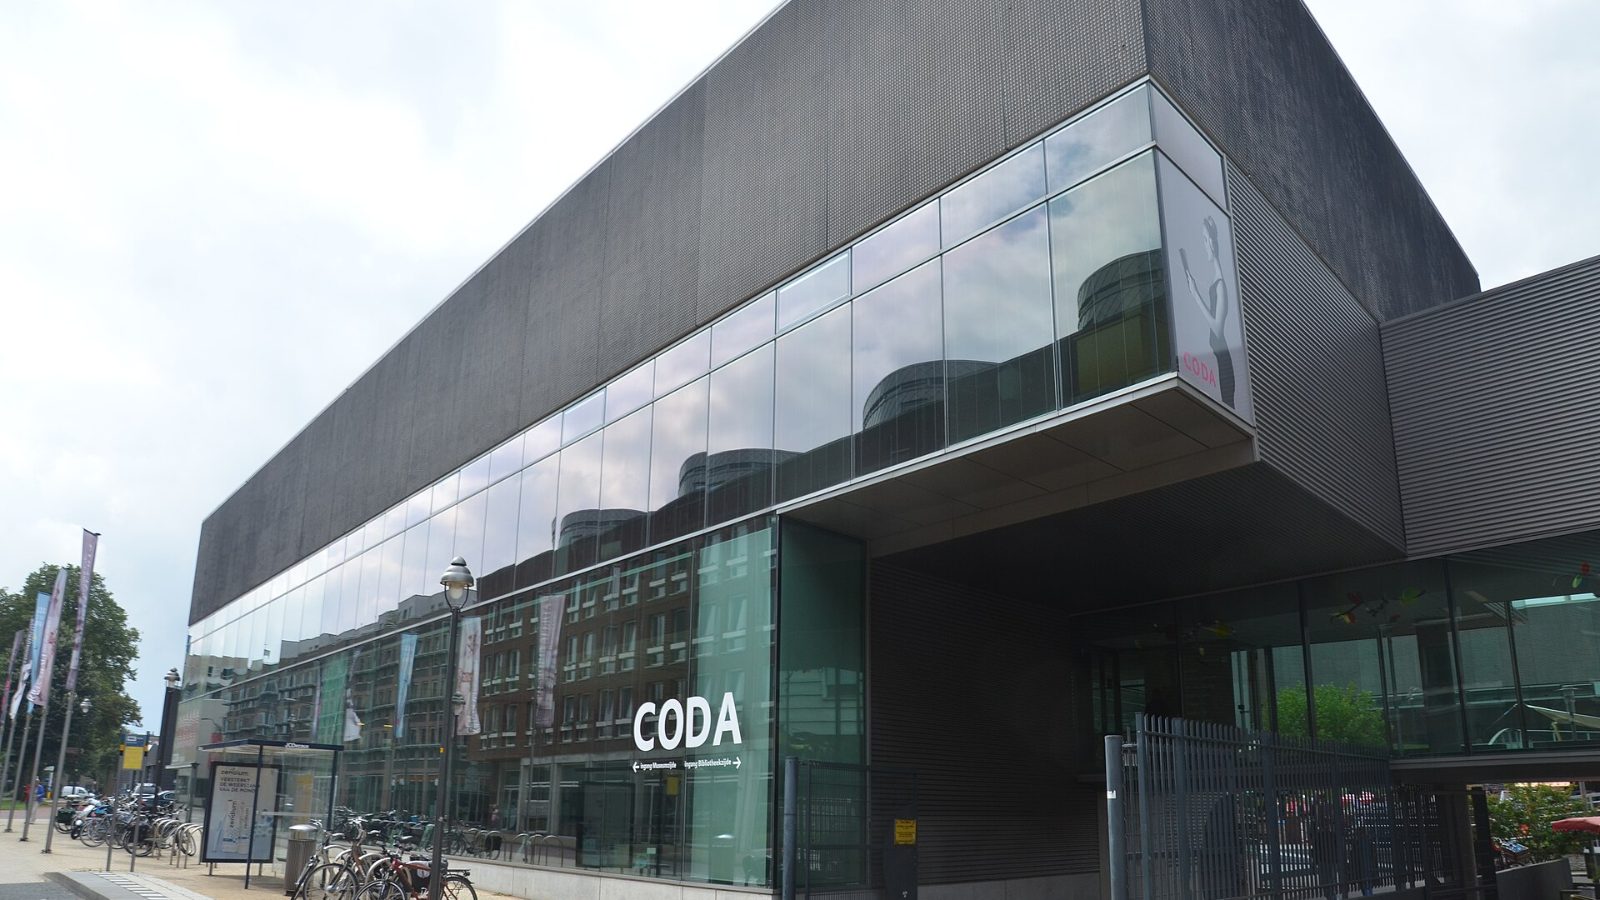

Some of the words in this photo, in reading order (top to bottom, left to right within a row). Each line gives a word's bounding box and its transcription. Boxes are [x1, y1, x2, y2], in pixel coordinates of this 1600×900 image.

[1183, 351, 1216, 387] CODA
[633, 691, 743, 752] CODA
[698, 757, 731, 767] Bibliotheekzijde
